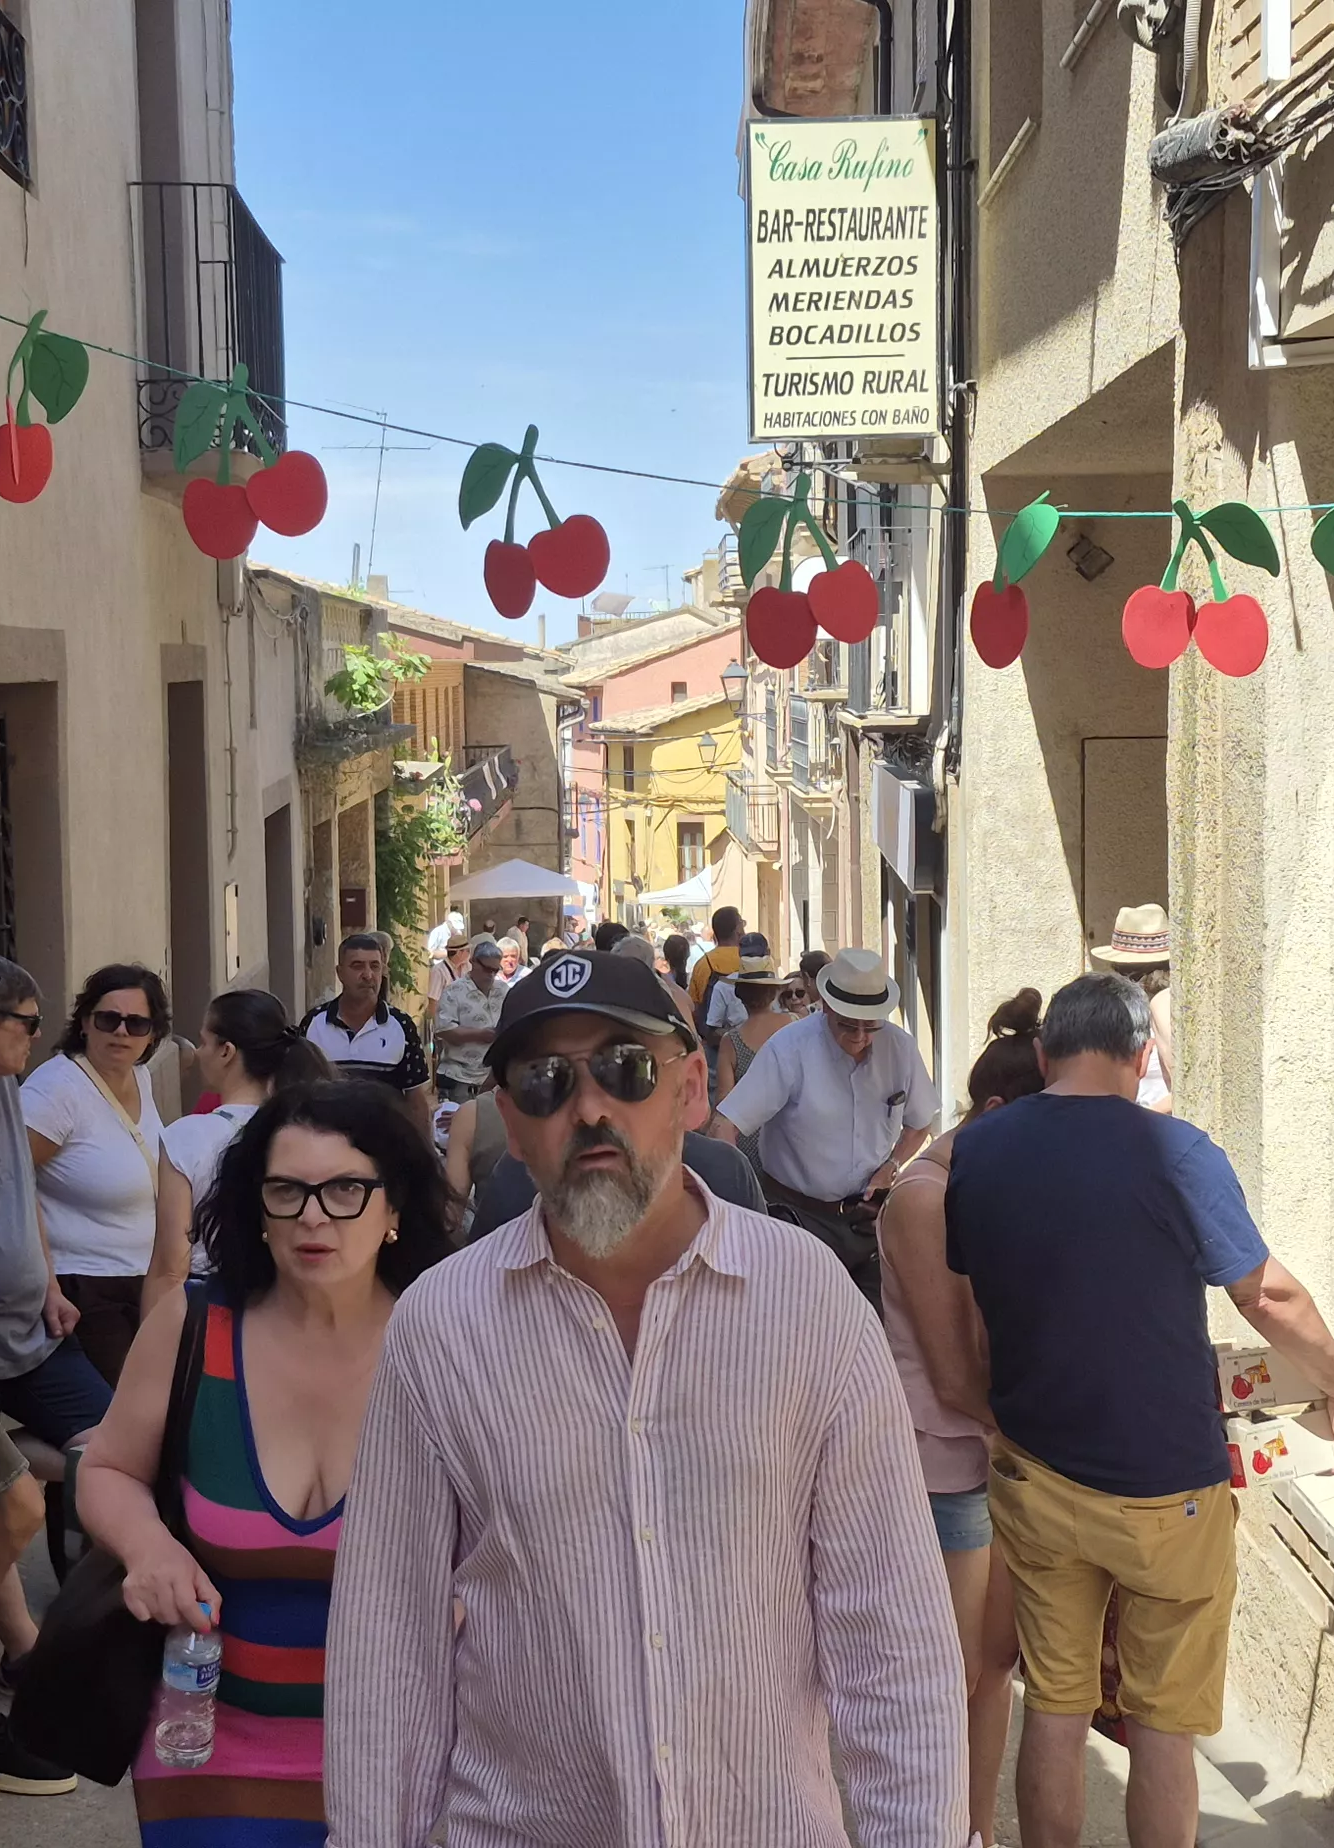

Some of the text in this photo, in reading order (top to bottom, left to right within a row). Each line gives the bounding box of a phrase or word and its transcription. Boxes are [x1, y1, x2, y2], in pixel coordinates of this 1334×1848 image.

[757, 205, 928, 244] BAR-RESTAURANTE
[767, 255, 919, 279] ALMUERZOS
[768, 289, 914, 313] MERIENDAS
[769, 322, 921, 346] BOCADILLOS
[762, 369, 929, 397] TURISMO RURAL
[763, 406, 929, 429] HABITACIONES CON BAÑO
